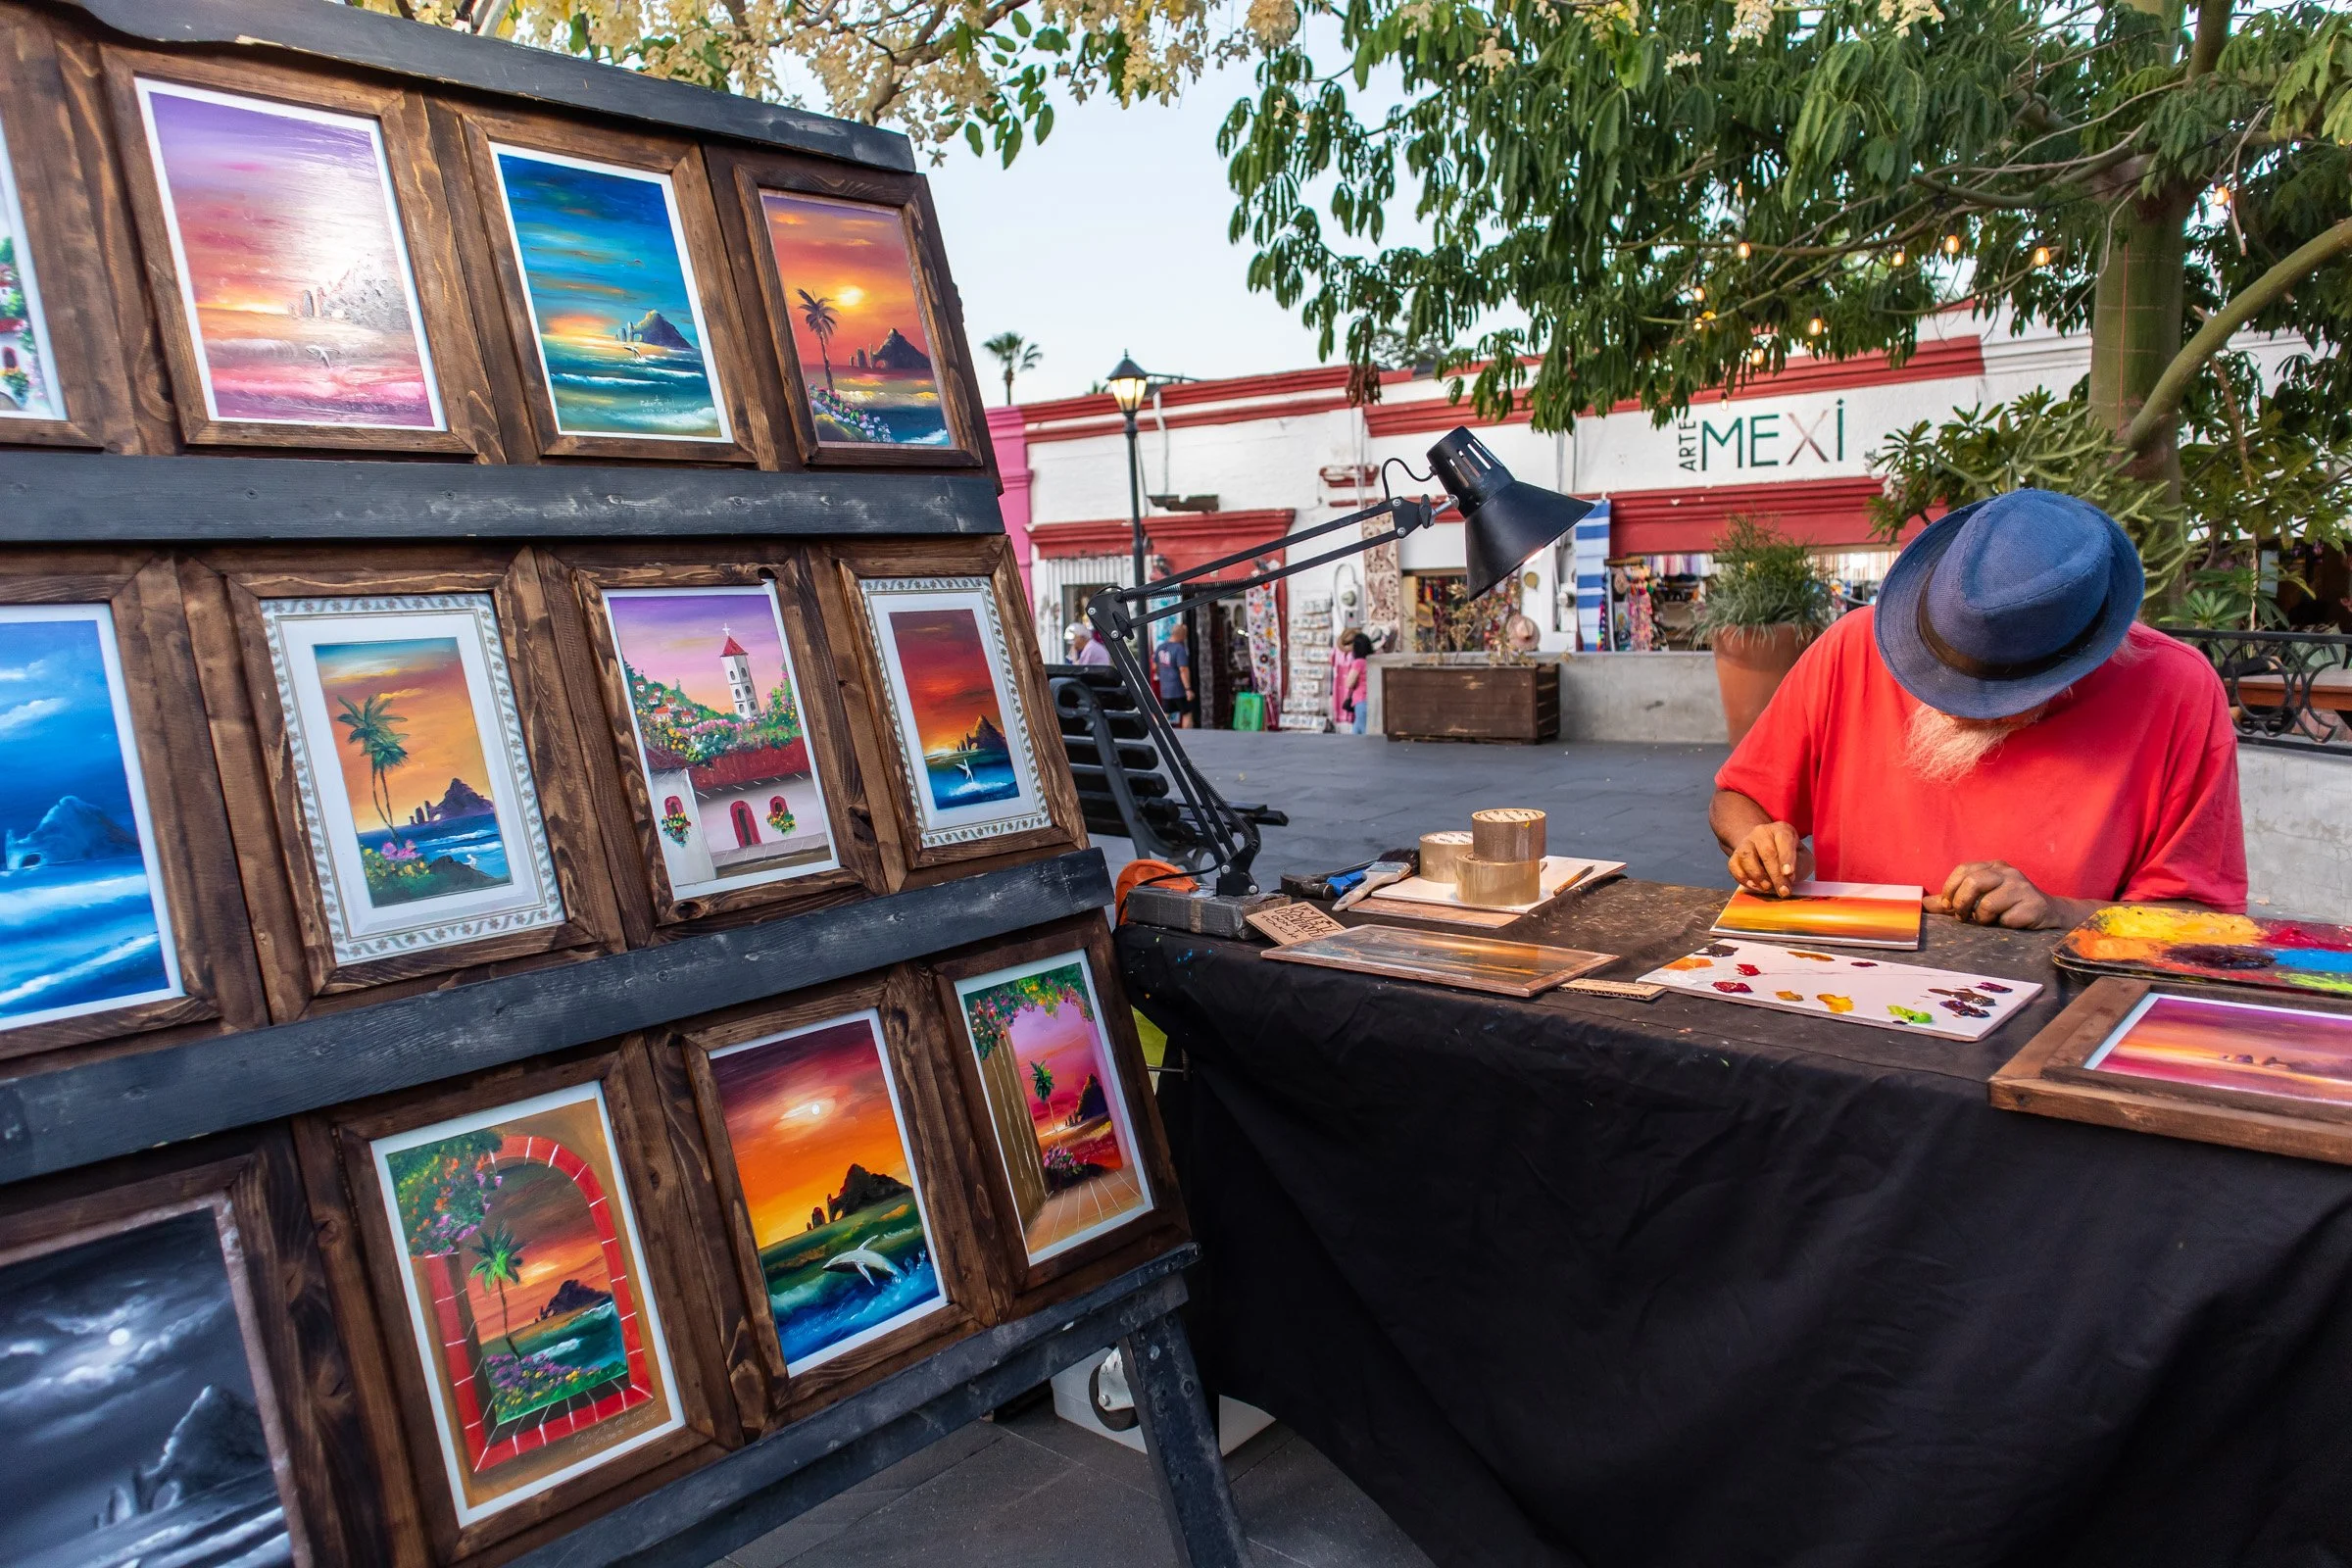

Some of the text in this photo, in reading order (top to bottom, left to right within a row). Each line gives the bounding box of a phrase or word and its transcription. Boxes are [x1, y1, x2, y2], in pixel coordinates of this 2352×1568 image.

[1679, 419, 1696, 471] ARTE
[1260, 913, 1298, 939] TOUCH
[1270, 914, 1304, 933] DON'T
[1290, 905, 1344, 934] WET
